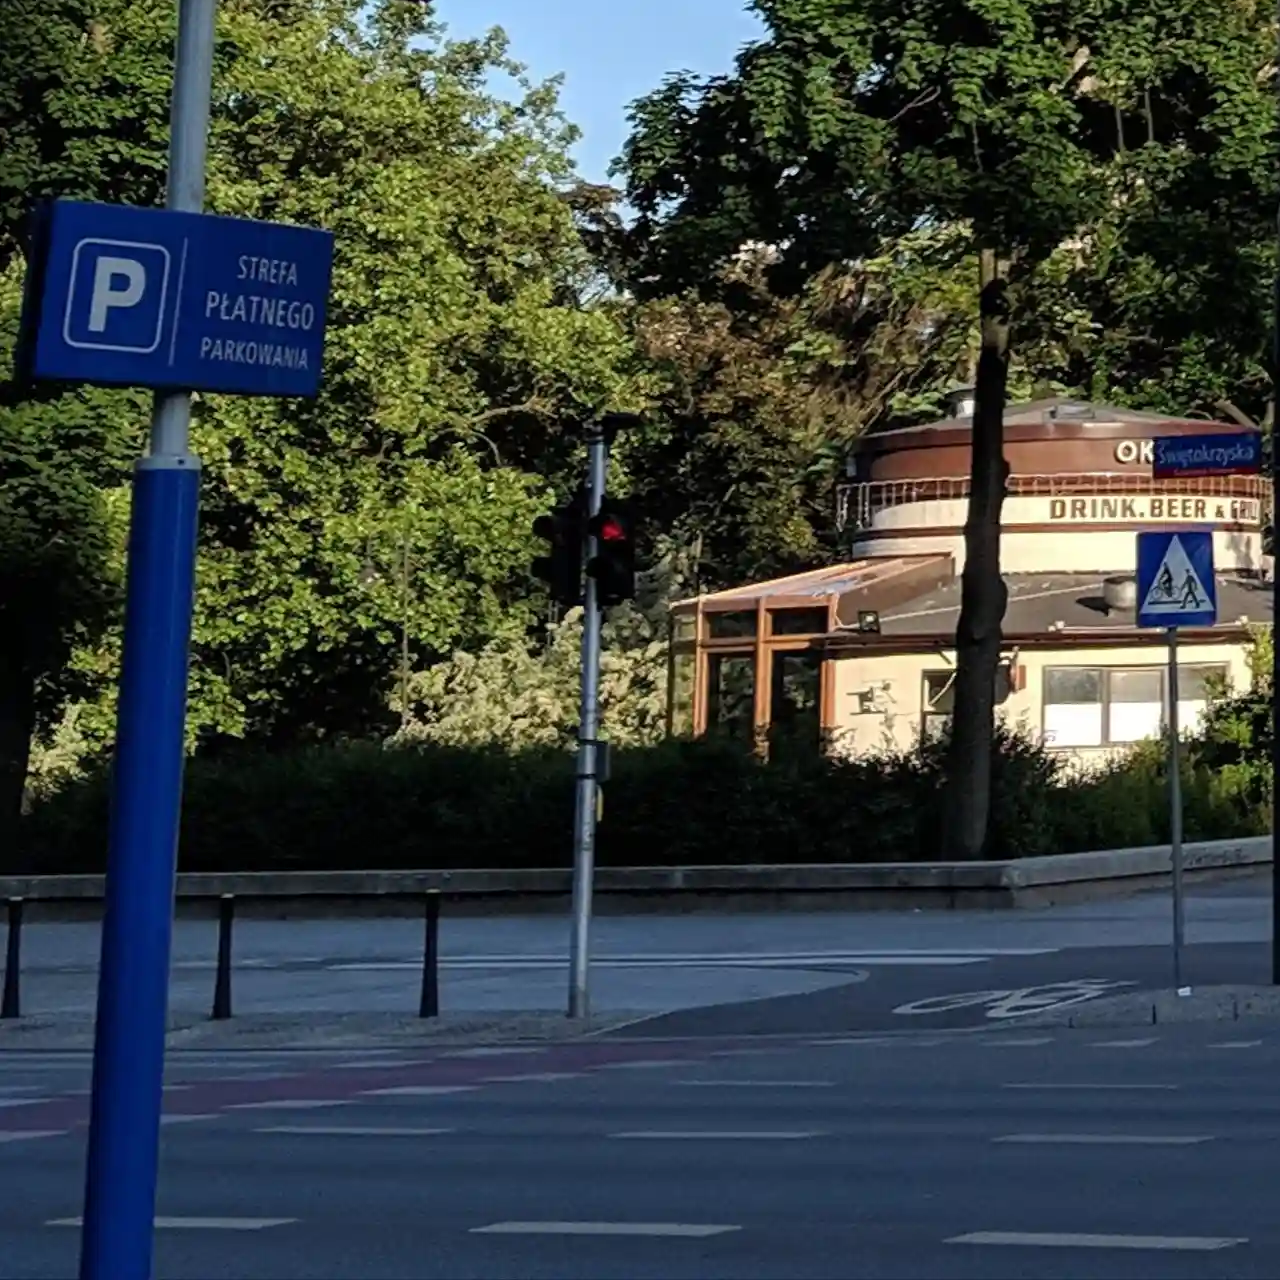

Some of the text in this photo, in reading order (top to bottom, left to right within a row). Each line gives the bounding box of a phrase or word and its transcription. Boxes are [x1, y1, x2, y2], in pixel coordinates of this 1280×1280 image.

[236, 254, 298, 287] STREFA
[87, 255, 147, 333] P
[205, 290, 315, 331] PŁATNEGO
[199, 336, 309, 370] PARKOWANIA
